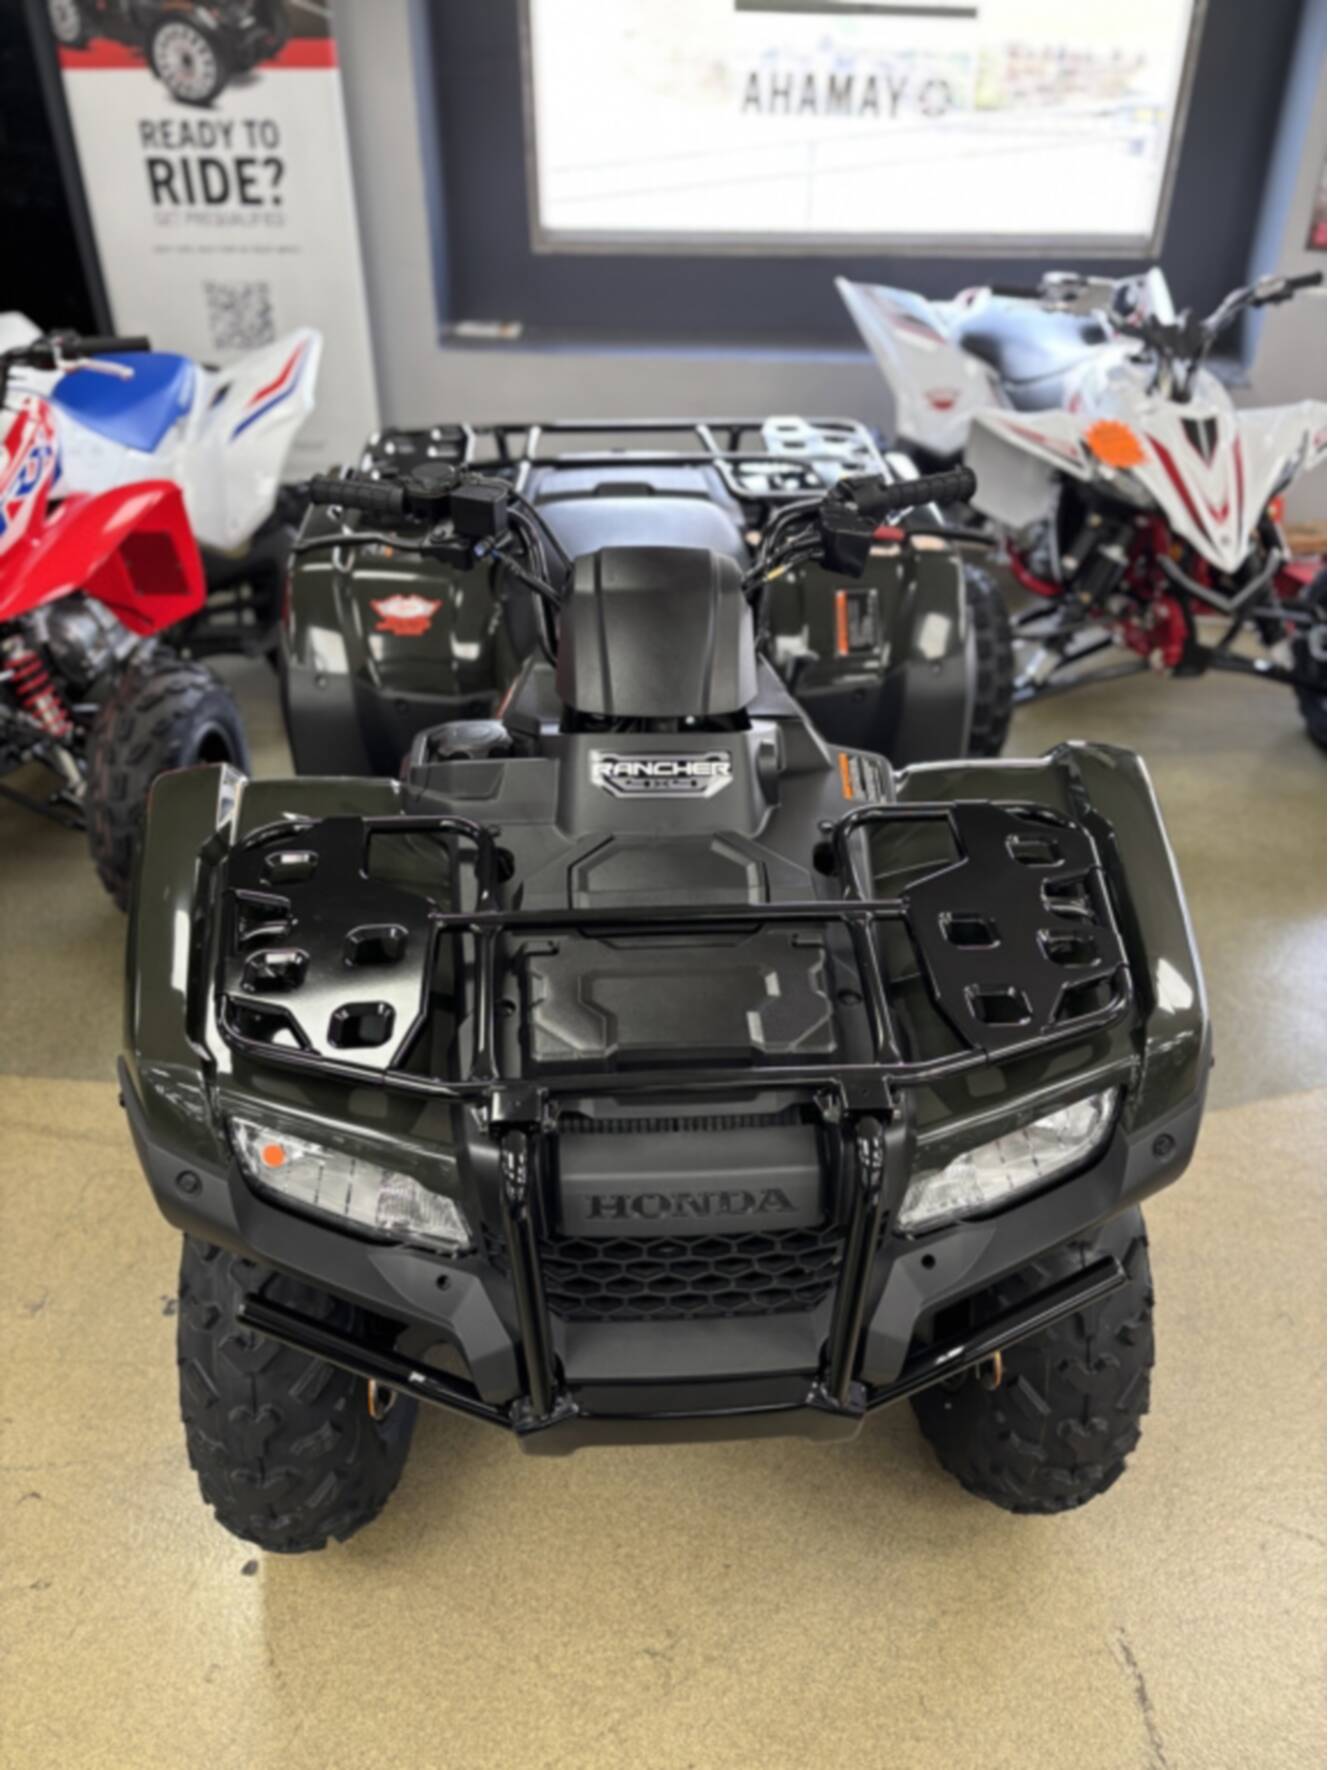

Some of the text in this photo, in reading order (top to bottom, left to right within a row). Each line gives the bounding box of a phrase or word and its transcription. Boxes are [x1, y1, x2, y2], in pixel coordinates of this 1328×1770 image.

[139, 119, 280, 149] READY TO
[146, 156, 285, 206] RIDE?
[591, 761, 732, 776] RANCHER
[586, 1188, 799, 1219] HONDA
